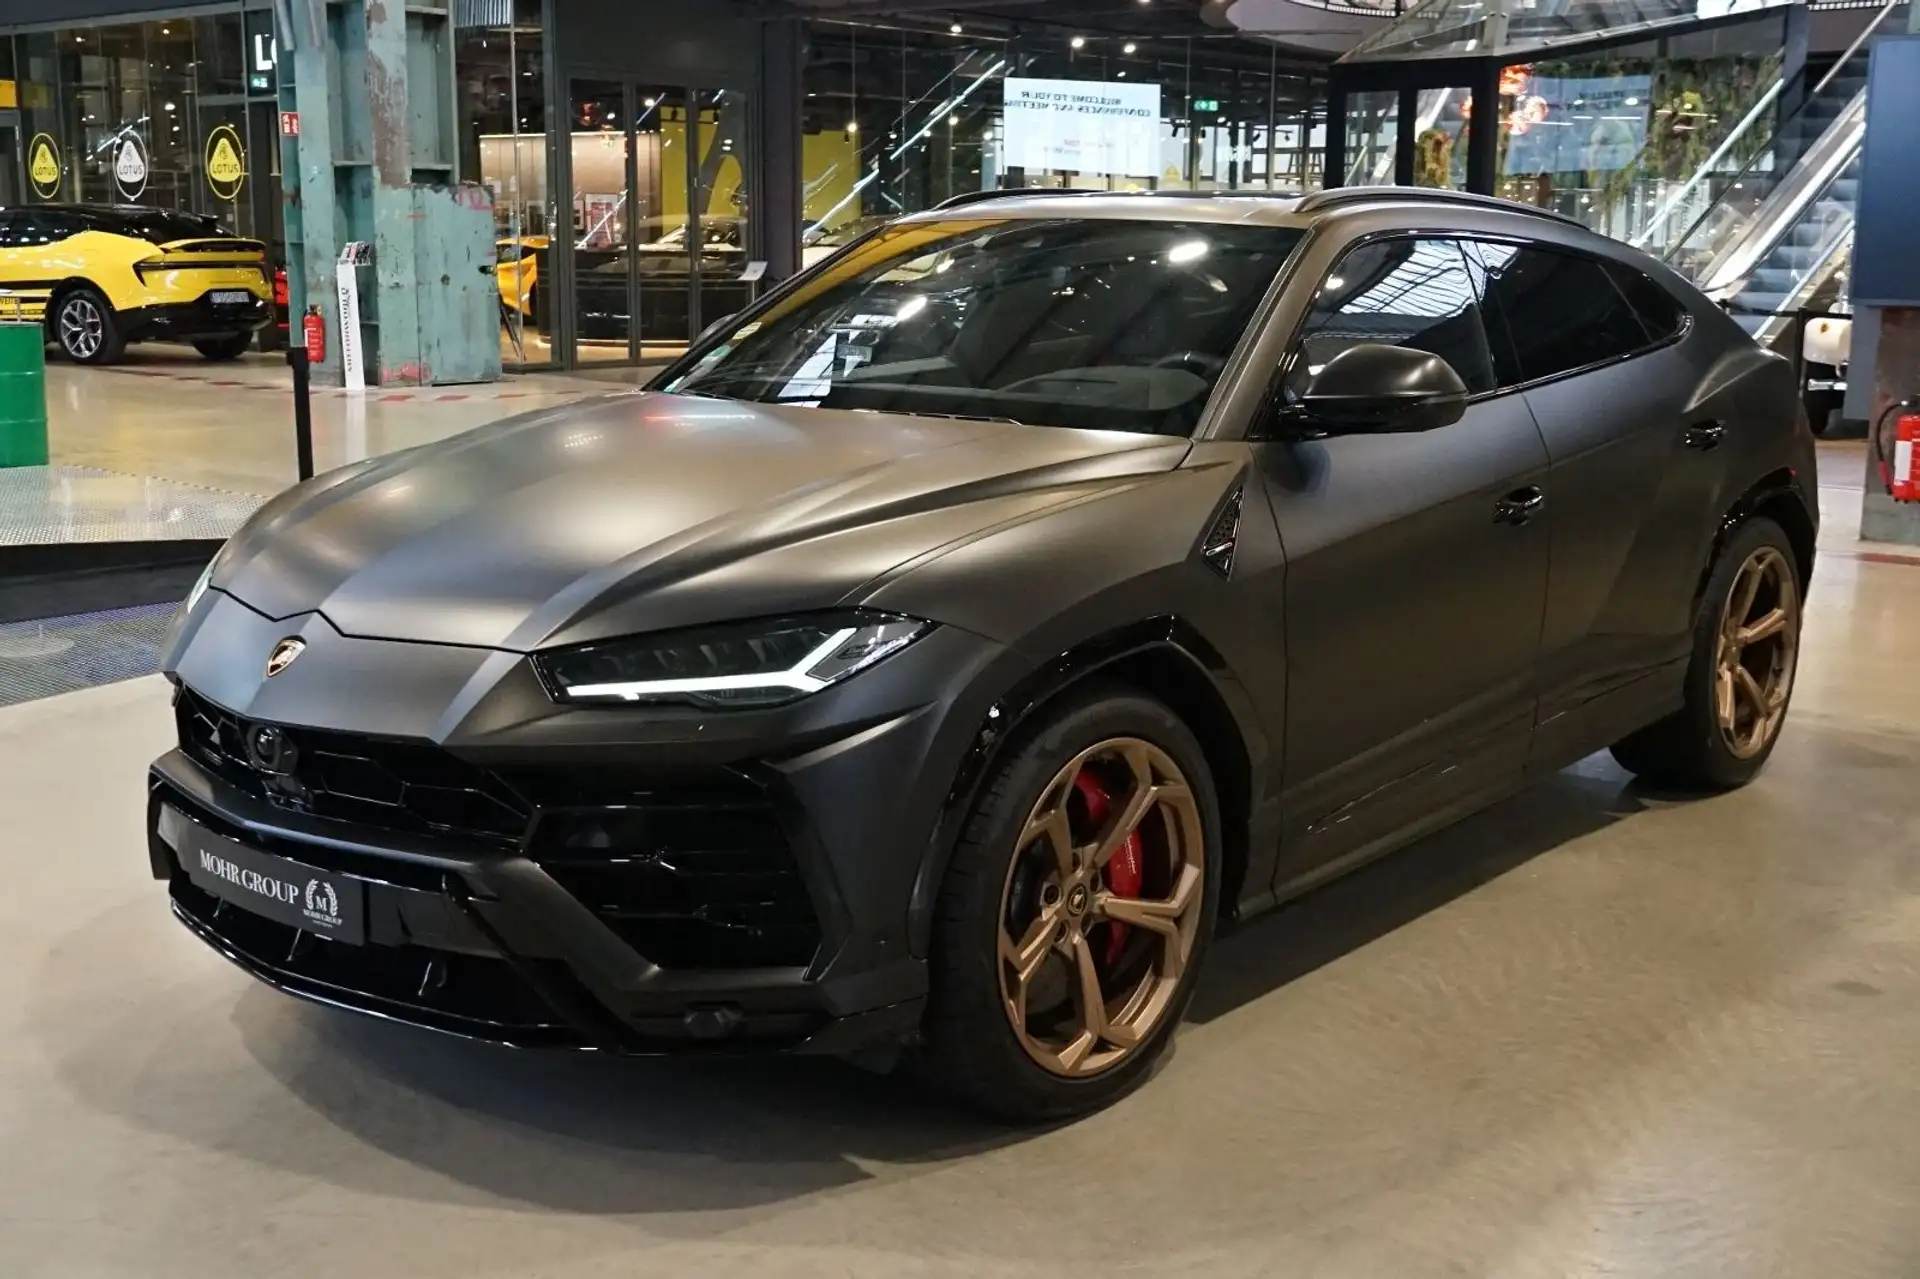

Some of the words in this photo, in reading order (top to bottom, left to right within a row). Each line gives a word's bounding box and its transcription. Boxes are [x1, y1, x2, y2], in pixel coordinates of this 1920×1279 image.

[254, 34, 278, 71] L
[34, 166, 57, 176] LOTUS
[118, 165, 144, 175] LOTUS
[212, 163, 240, 174] LOTUS
[199, 848, 242, 884] MOHR
[242, 869, 299, 905] GROUP
[315, 895, 328, 911] M
